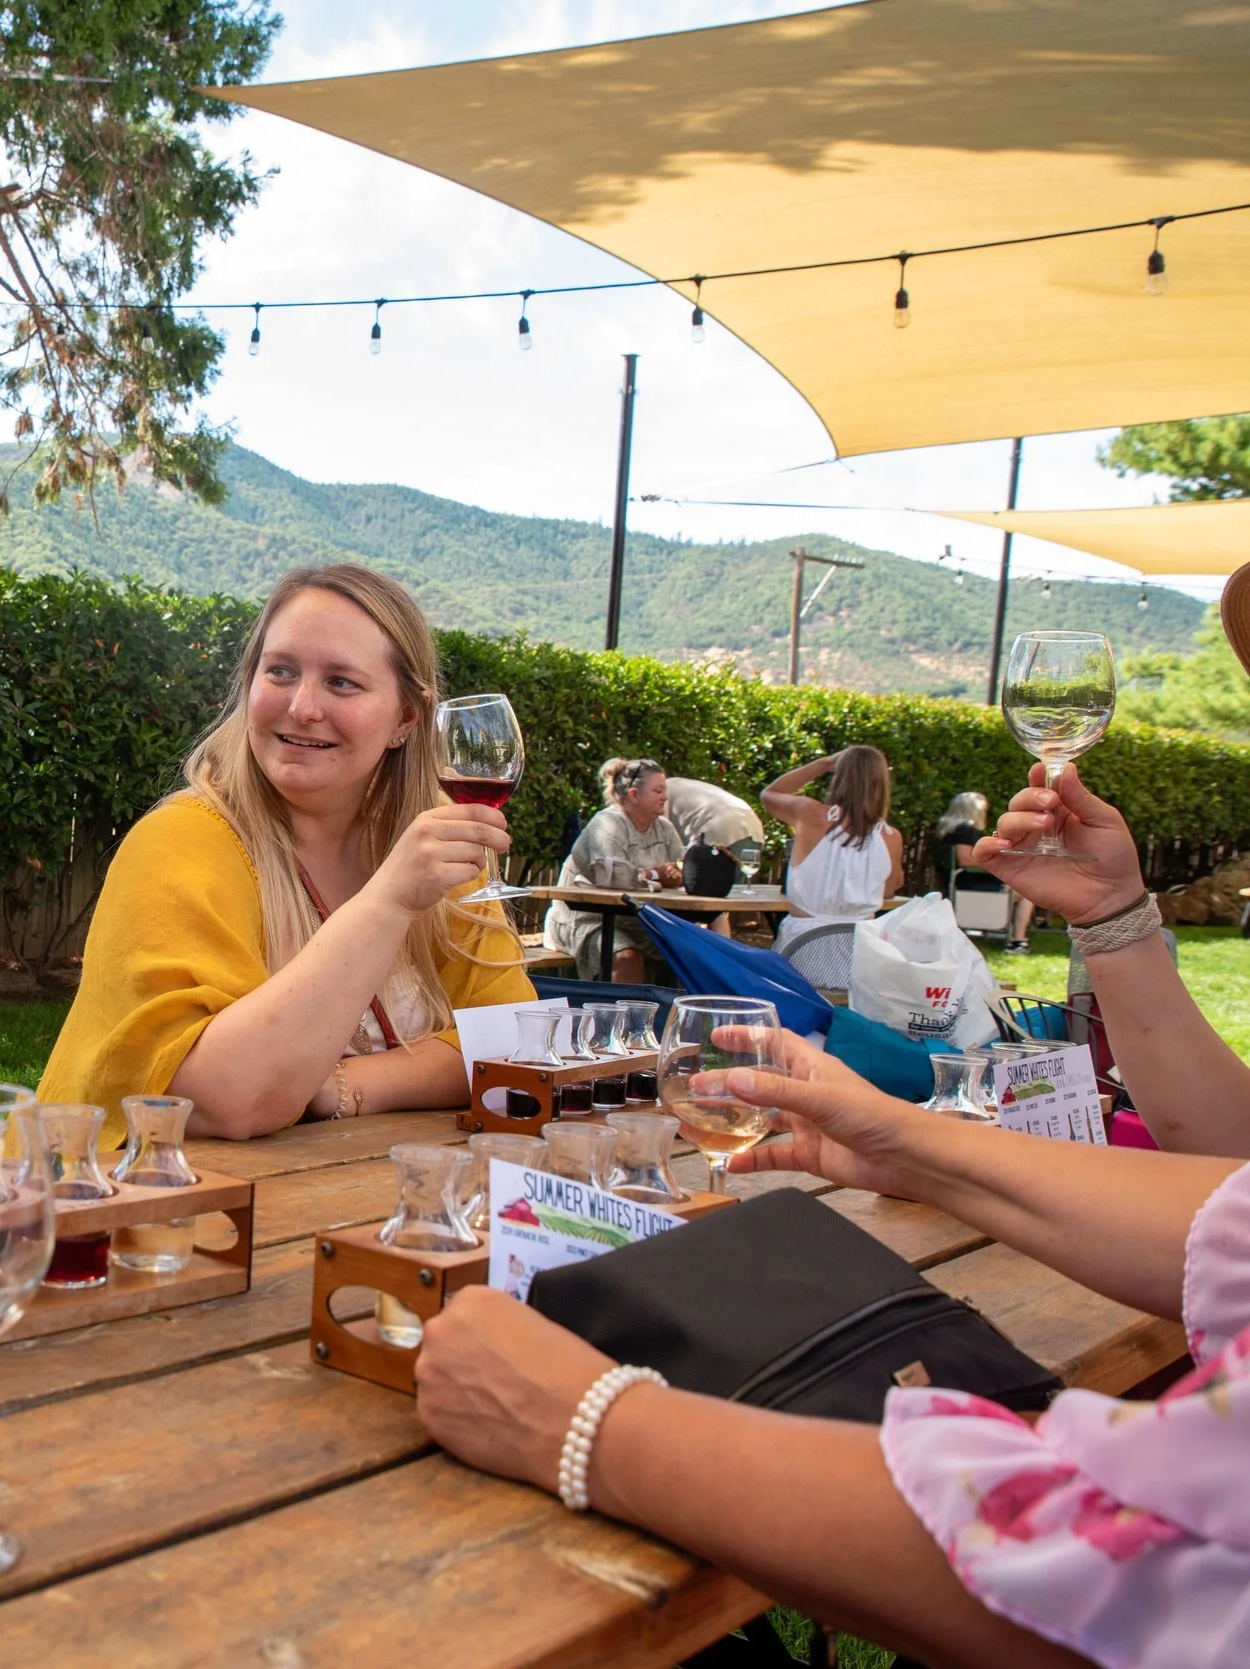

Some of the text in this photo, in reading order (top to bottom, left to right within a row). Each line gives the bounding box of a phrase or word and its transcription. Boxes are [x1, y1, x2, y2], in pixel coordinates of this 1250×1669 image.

[1007, 1057, 1066, 1085] SUMMER WHITES FLIGHT
[523, 1172, 584, 1216] SUMMER
[586, 1190, 632, 1231] WHITES
